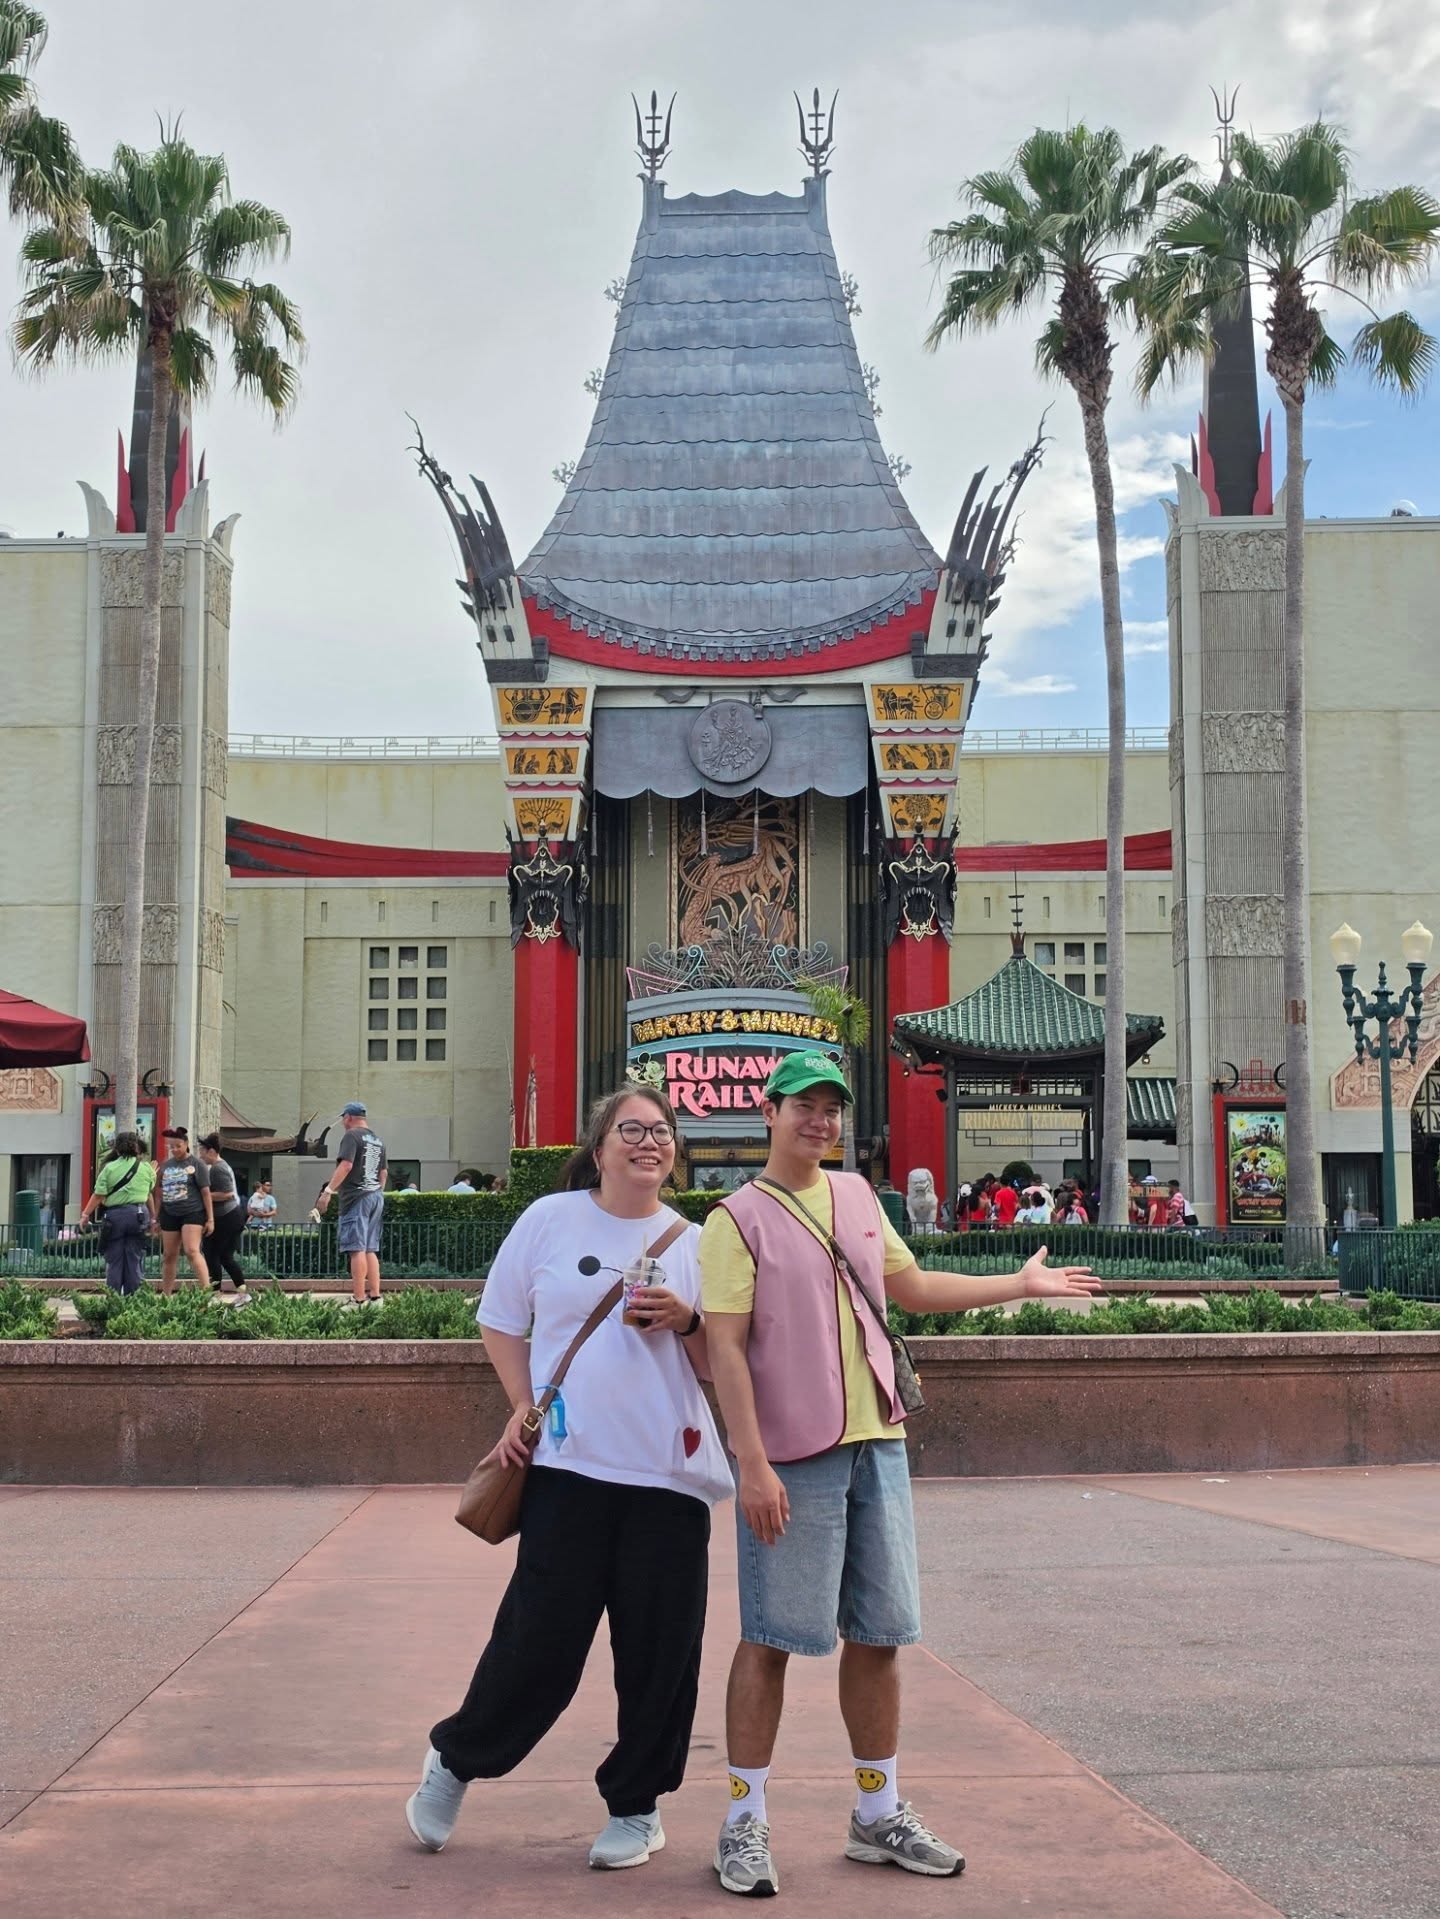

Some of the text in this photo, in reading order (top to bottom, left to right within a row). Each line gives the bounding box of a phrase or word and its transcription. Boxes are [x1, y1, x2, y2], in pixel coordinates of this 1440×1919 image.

[632, 1011, 717, 1043] MICKEY
[720, 1009, 738, 1031] &
[665, 1053, 784, 1081] RUNAW
[965, 1111, 1087, 1130] RUNAWAY RAILWAY
[886, 1831, 903, 1848] N
